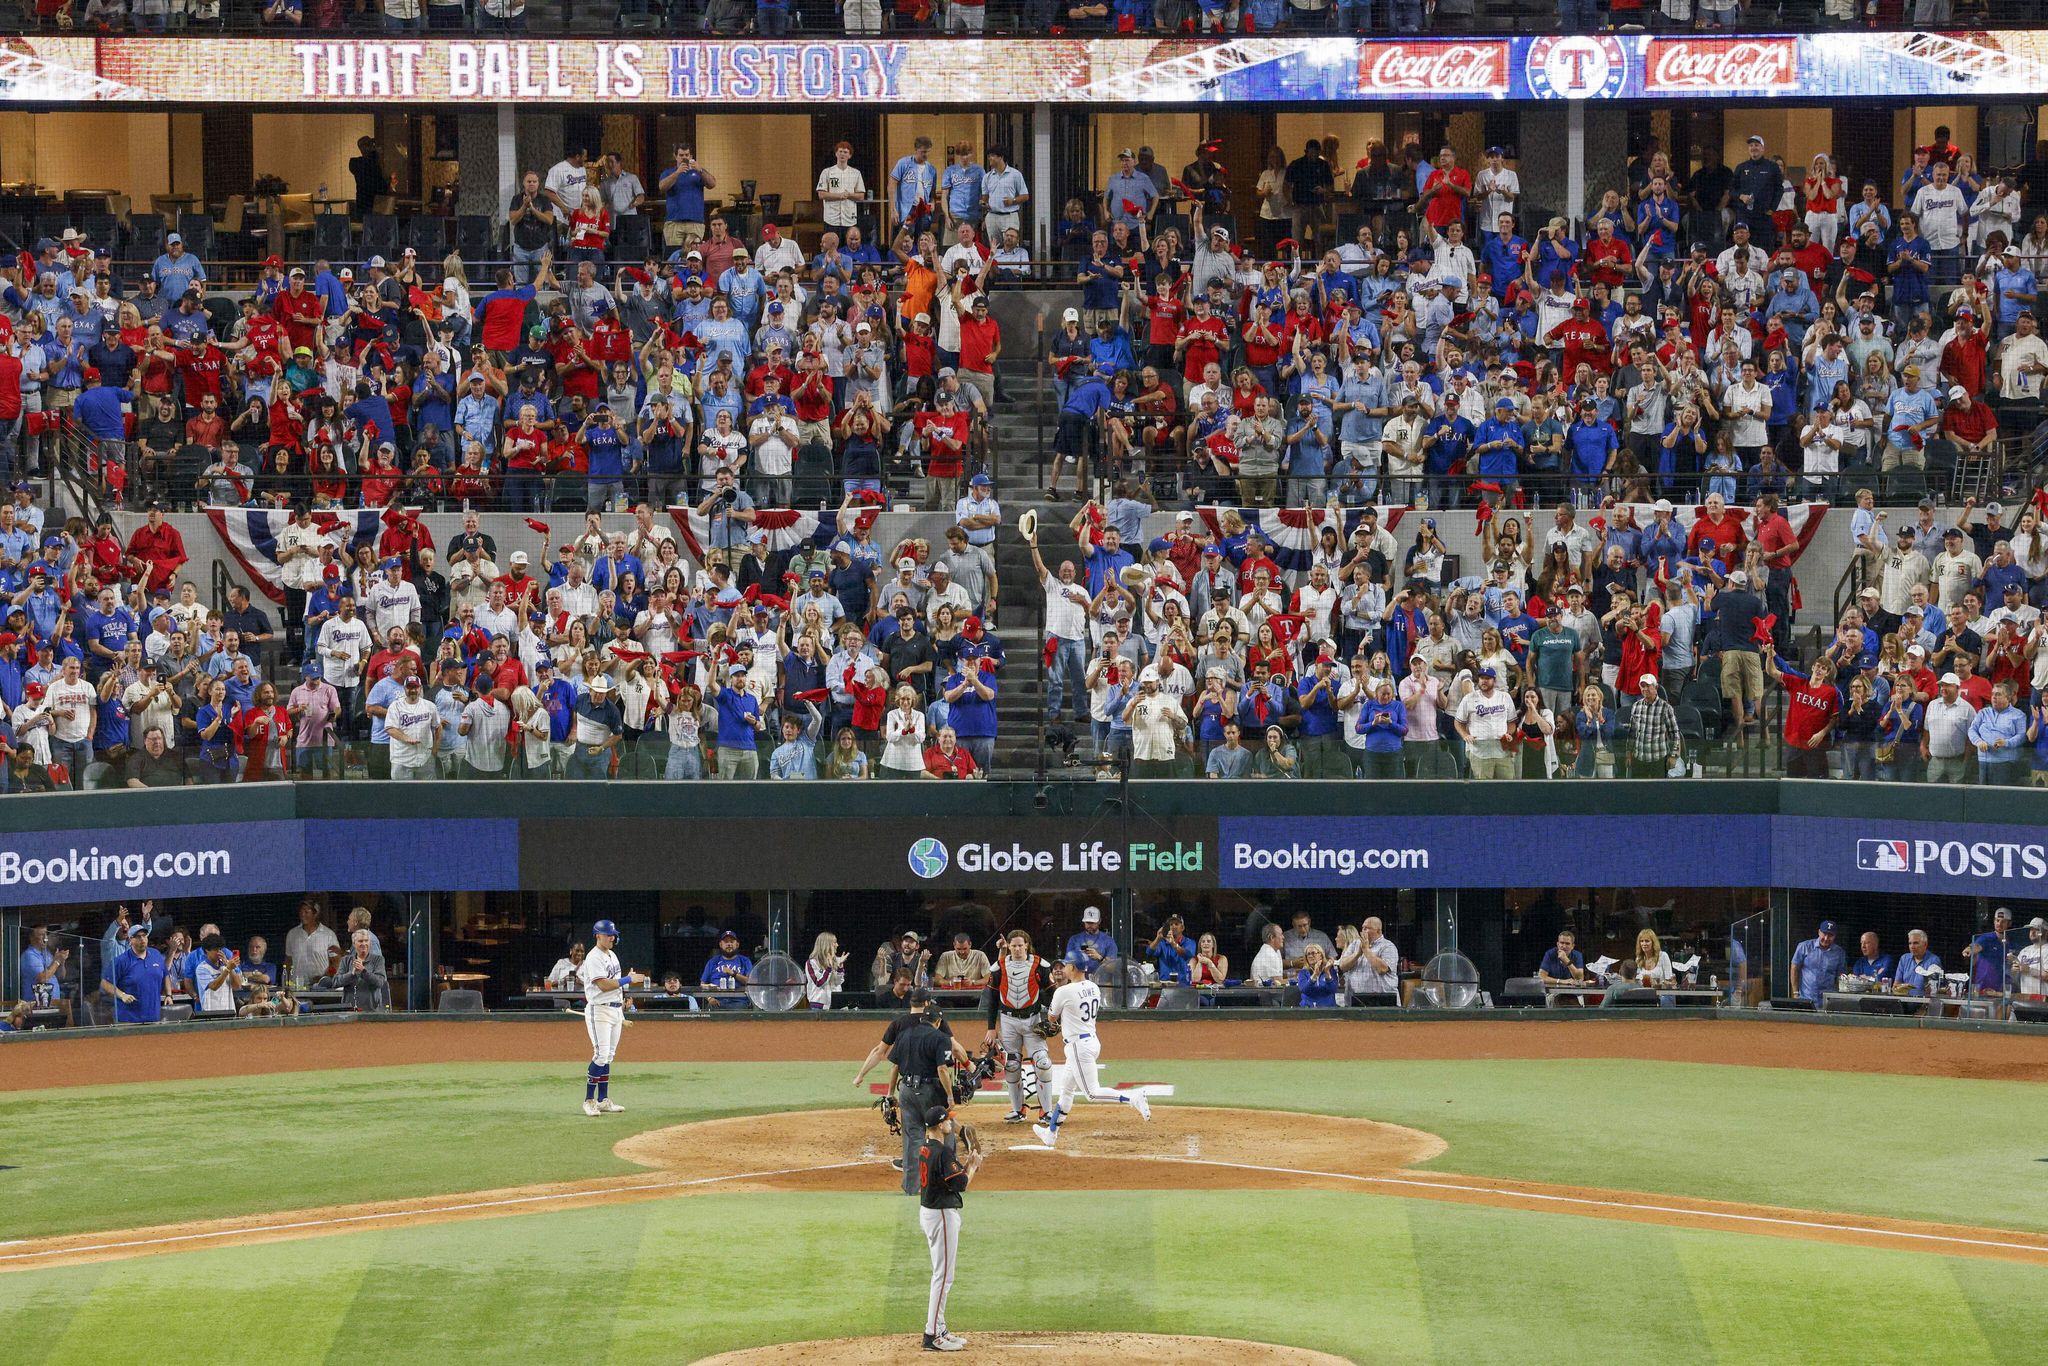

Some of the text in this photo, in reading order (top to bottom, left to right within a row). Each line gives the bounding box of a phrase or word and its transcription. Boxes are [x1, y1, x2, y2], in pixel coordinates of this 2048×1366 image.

[294, 43, 906, 99] THAT BALL IS HISTORY
[1371, 46, 1501, 87] Coca-Cola
[1560, 49, 1595, 89] T
[1656, 43, 1787, 86] Coca-Cola
[1925, 199, 1955, 211] Rangers
[1413, 278, 1439, 292] Rangers
[1545, 296, 1571, 309] Rangers
[74, 320, 96, 331] EXAS
[766, 336, 790, 347] TEXAS
[593, 437, 617, 445] TEXAS
[1217, 445, 1240, 457] TEXA
[379, 596, 411, 608] Rangers
[102, 622, 128, 633] TEXAS
[1279, 619, 1293, 636] T
[332, 630, 361, 643] Rangers
[1158, 684, 1185, 695] EXAS
[1796, 691, 1828, 711] TEXAS
[1475, 704, 1505, 717] Rangers
[401, 713, 425, 727] Rangers
[956, 841, 1203, 873] Globe Life Field
[1234, 842, 1429, 876] Booking.com
[1914, 840, 2047, 879] POSTS
[0, 847, 231, 887] Booking.com
[1078, 988, 1096, 999] LOWE
[1079, 1000, 1099, 1023] 30
